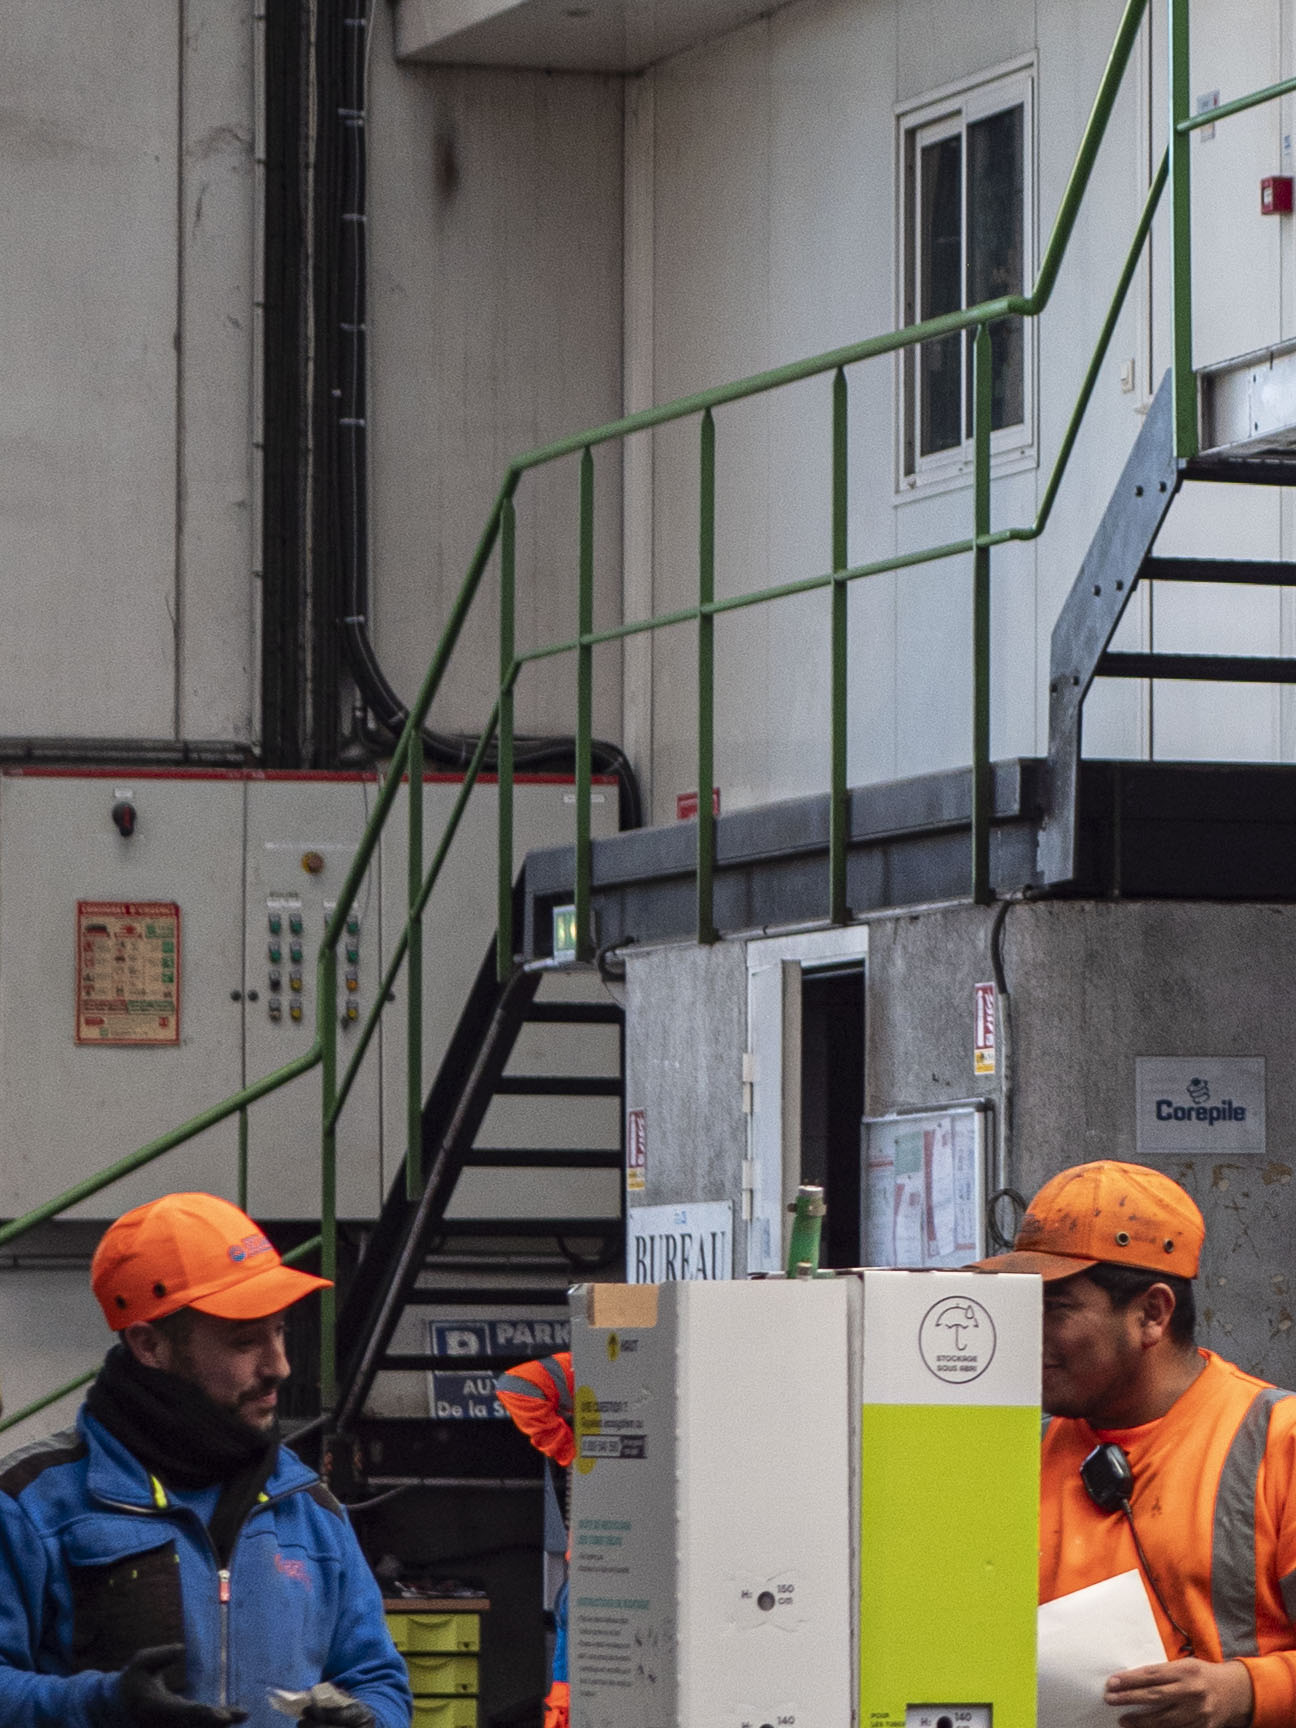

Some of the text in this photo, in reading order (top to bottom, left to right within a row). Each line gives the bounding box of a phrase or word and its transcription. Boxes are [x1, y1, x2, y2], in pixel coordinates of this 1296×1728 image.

[1156, 1098, 1247, 1127] Corepile
[635, 1231, 727, 1285] BUREAU
[463, 1378, 499, 1396] AU
[437, 1401, 463, 1417] De
[468, 1399, 489, 1418] la
[777, 1584, 795, 1594] 150
[777, 1716, 795, 1725] 140
